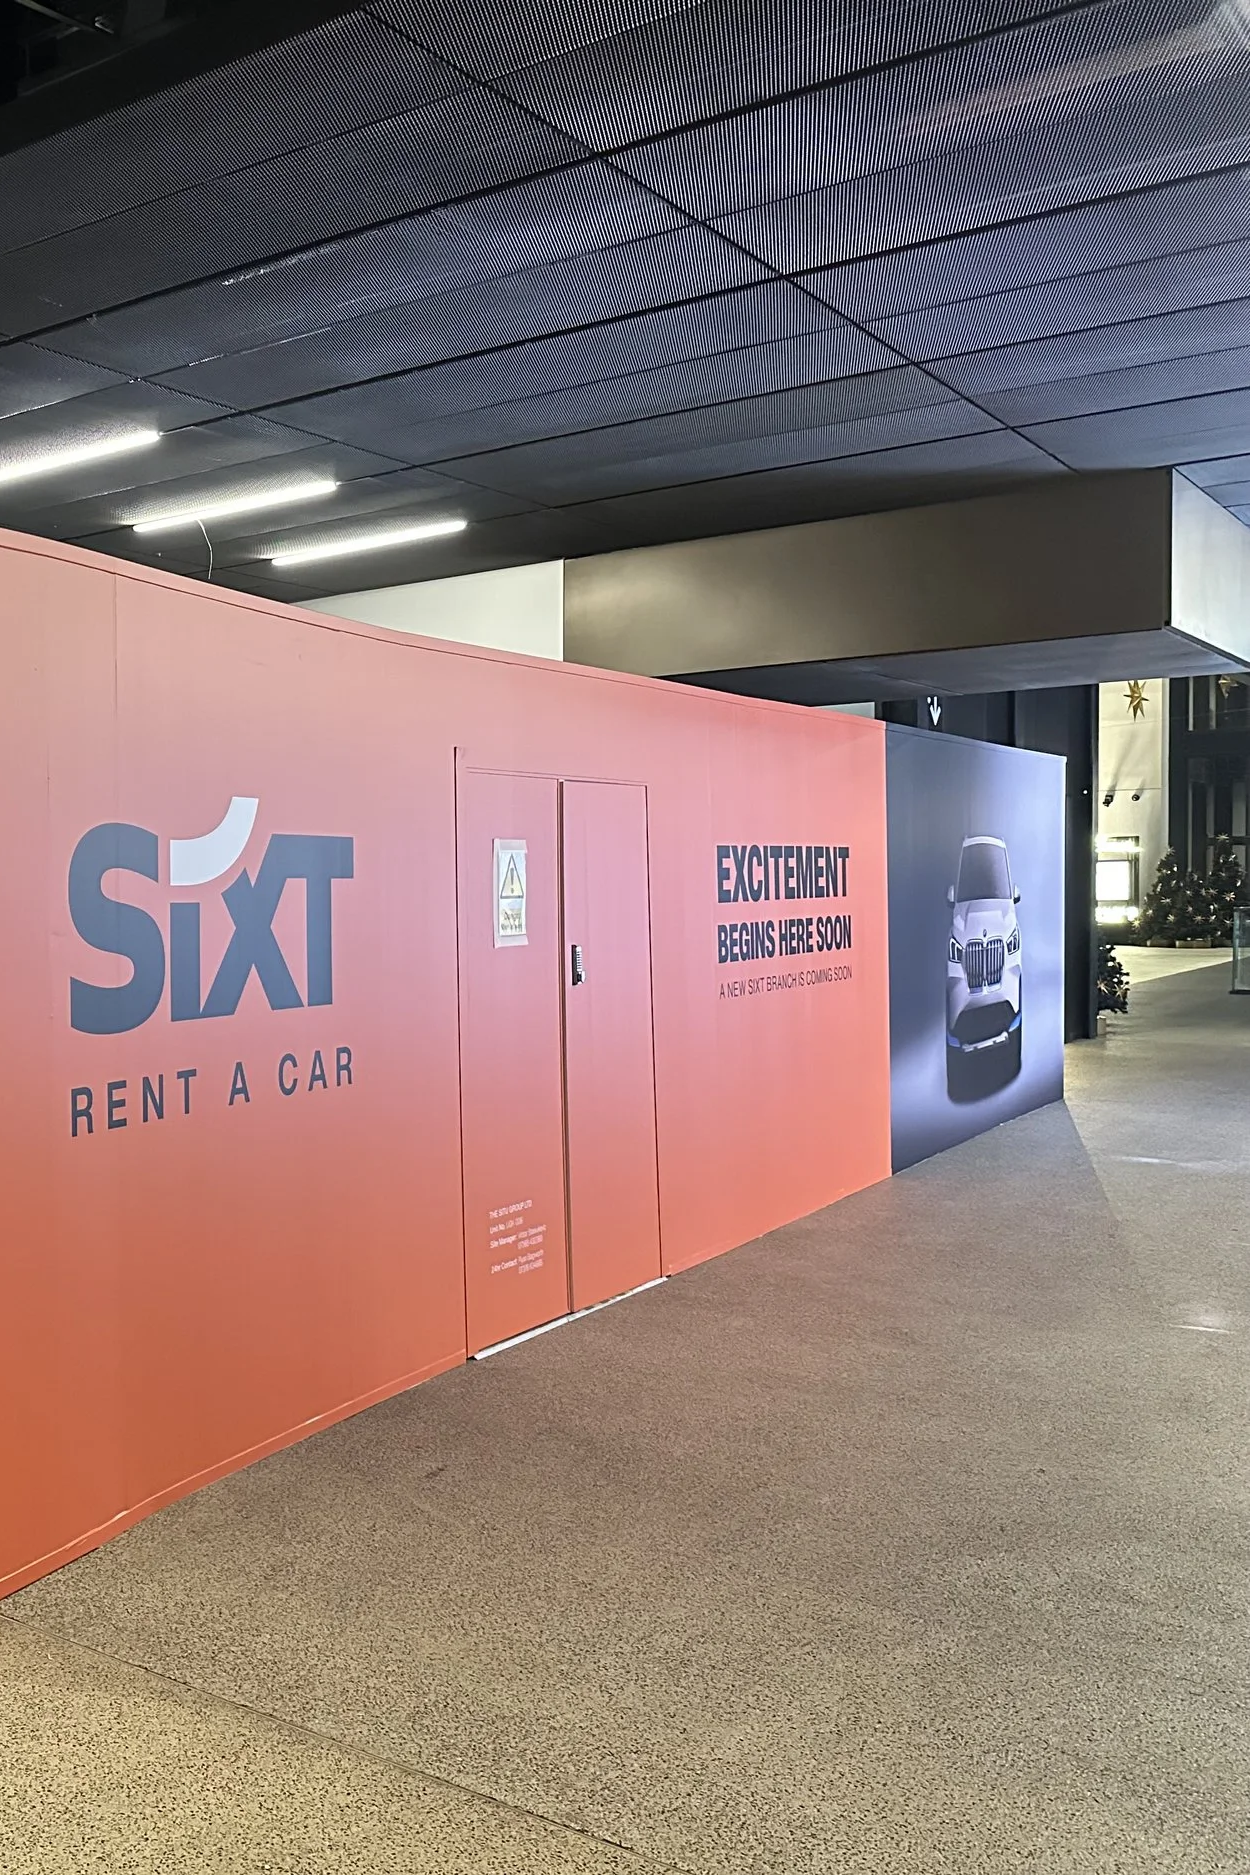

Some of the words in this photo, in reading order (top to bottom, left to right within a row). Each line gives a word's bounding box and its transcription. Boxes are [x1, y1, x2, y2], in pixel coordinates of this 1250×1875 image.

[717, 845, 850, 903] EXCITEMENT
[718, 920, 775, 964] BEGINS
[779, 917, 814, 957] HERE
[816, 915, 852, 952] SOON
[719, 983, 726, 1000] A
[727, 980, 746, 999] NEW
[748, 977, 765, 995] SIXT
[766, 973, 796, 992] BRANCH
[798, 971, 805, 987] IS
[806, 967, 833, 986] COMING
[833, 964, 852, 982] SOON
[71, 1068, 197, 1138] RENT
[228, 1061, 250, 1106] A
[278, 1046, 353, 1097] CAR
[509, 1202, 524, 1213] GROUP
